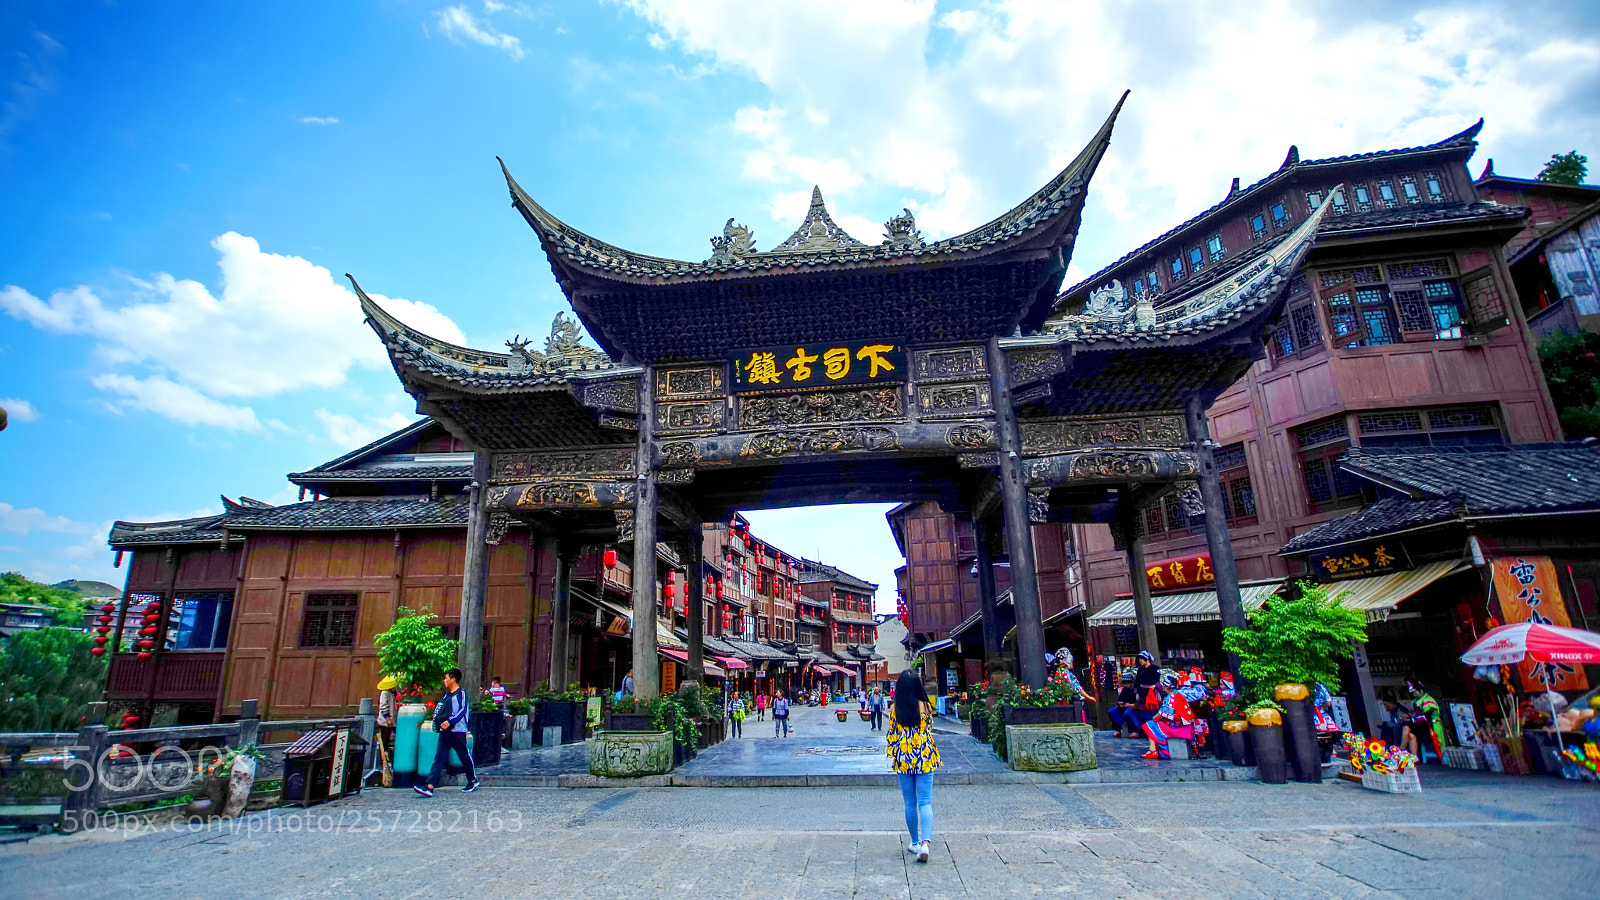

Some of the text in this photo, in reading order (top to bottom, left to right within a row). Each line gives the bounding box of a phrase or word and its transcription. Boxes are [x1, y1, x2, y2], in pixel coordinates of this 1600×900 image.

[744, 343, 896, 385] 下司古鎮
[1321, 545, 1396, 574] 雷公山茶
